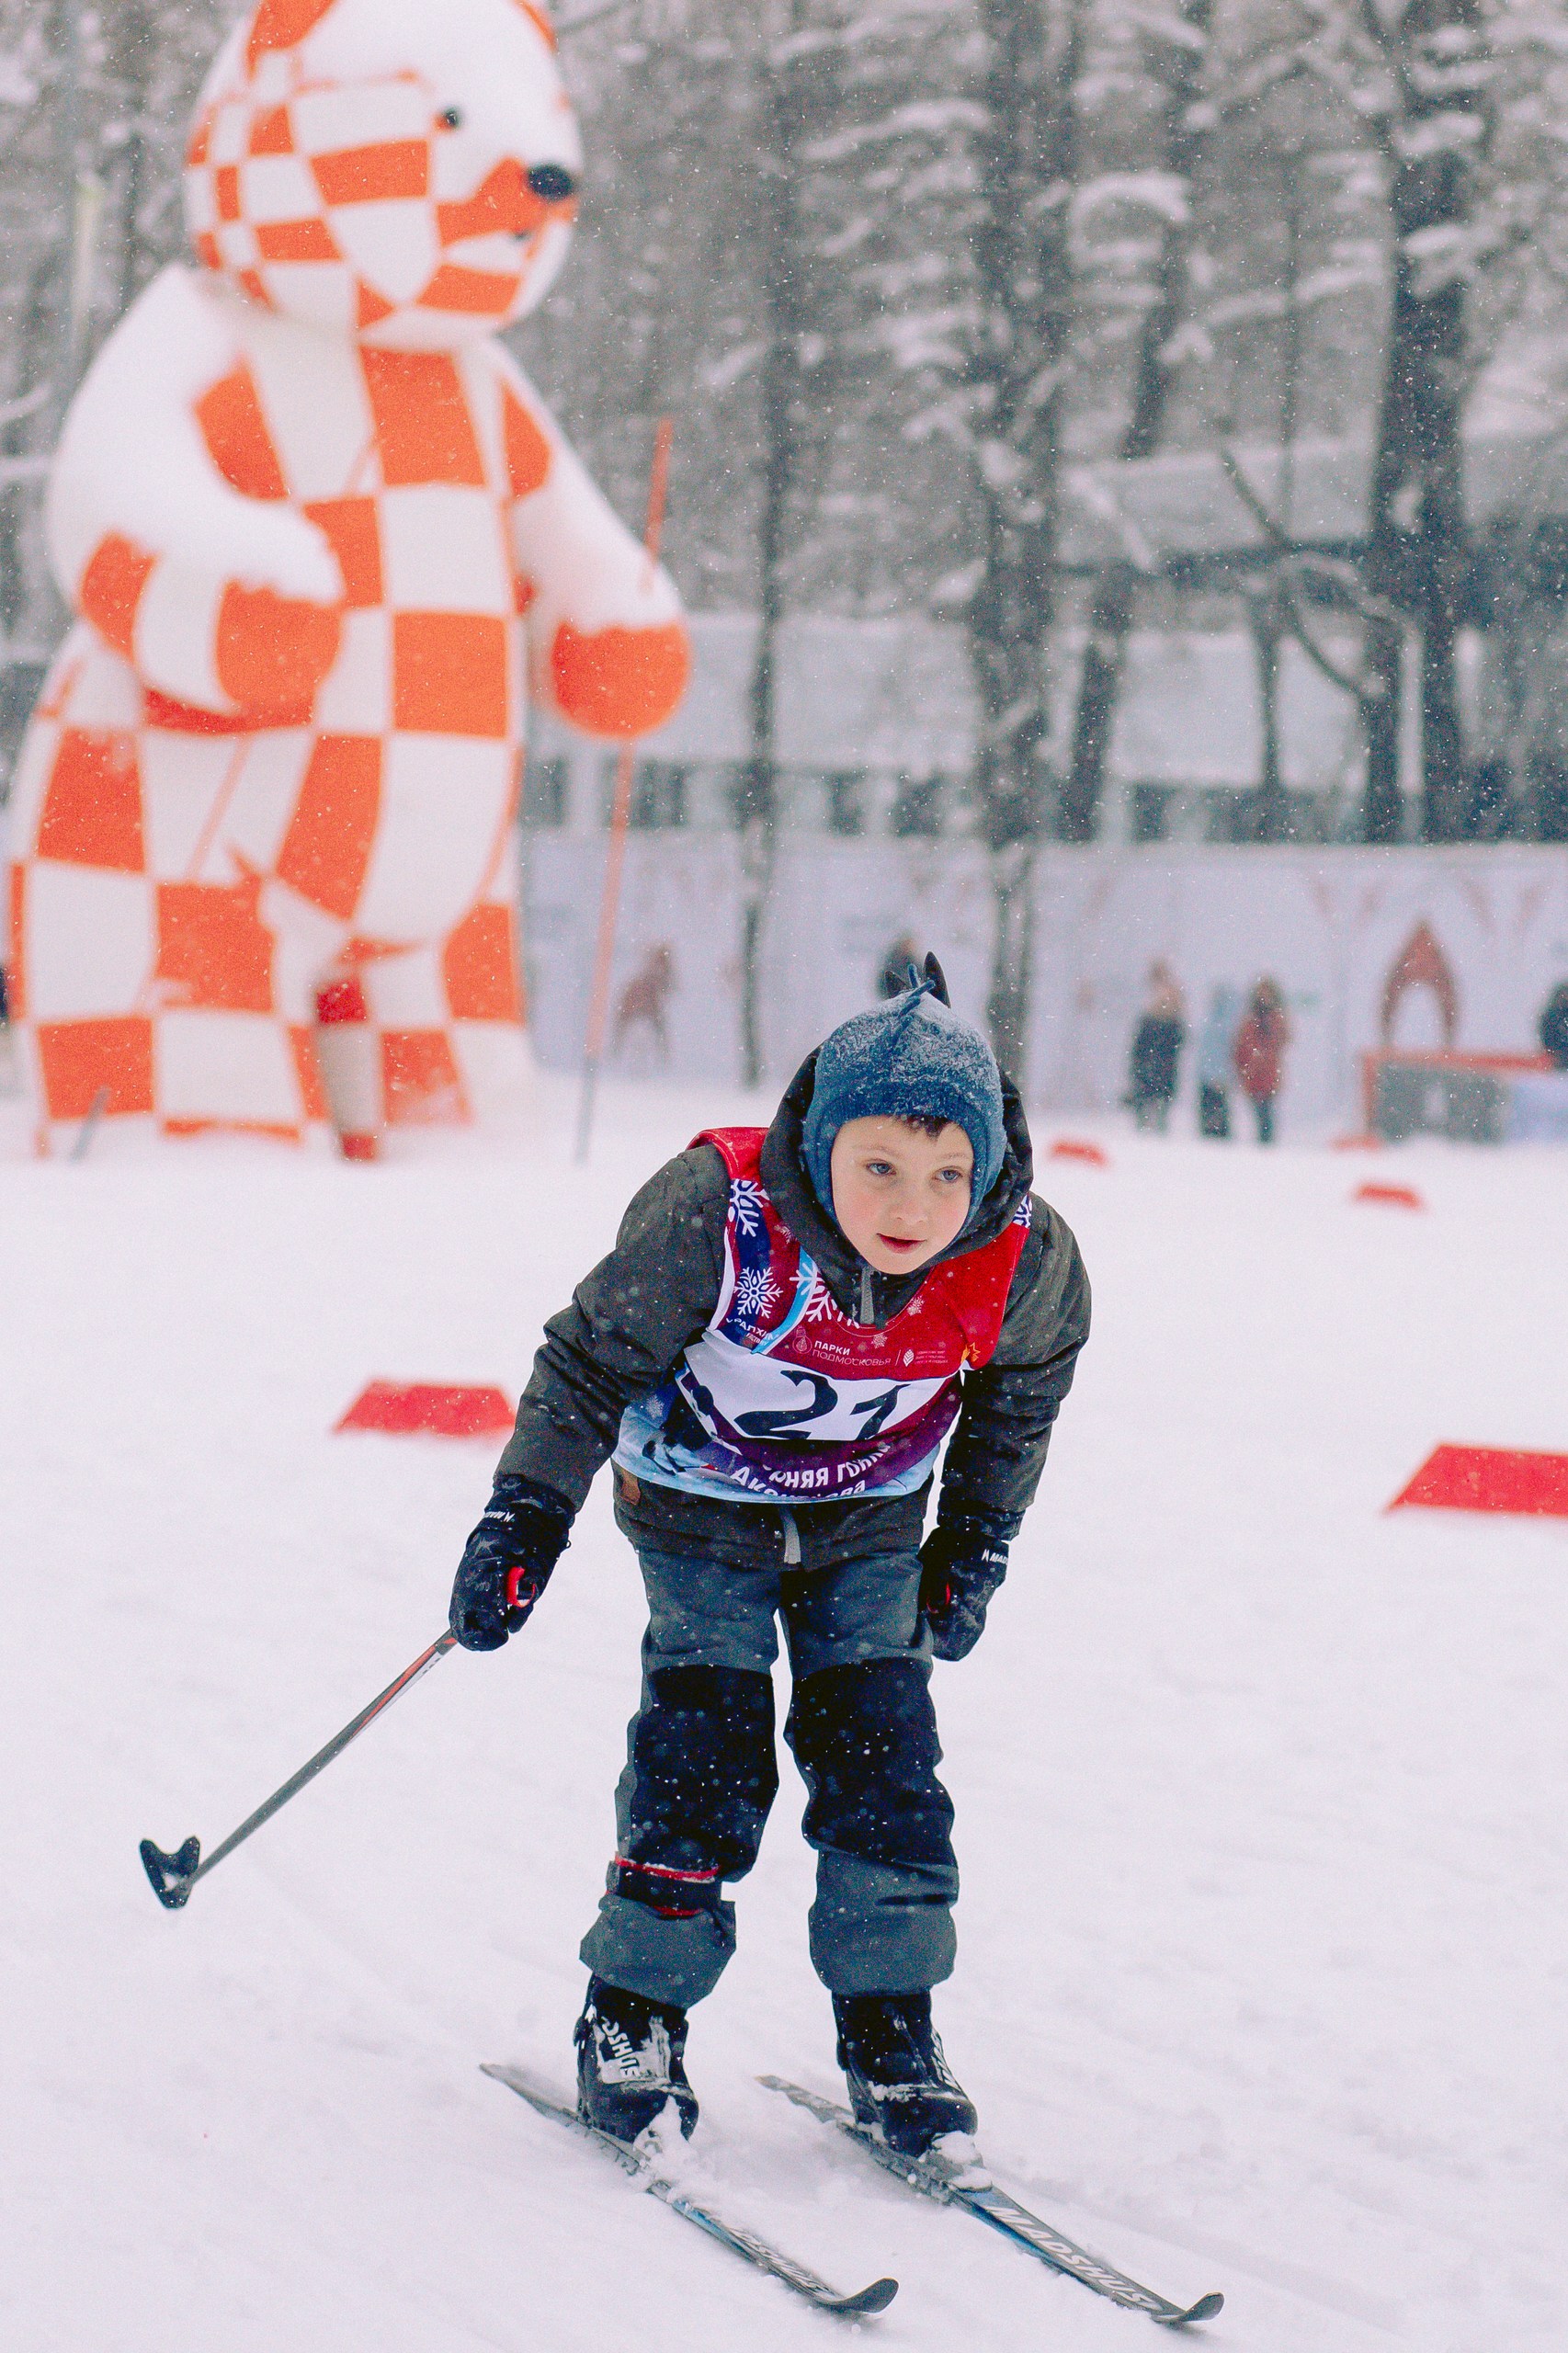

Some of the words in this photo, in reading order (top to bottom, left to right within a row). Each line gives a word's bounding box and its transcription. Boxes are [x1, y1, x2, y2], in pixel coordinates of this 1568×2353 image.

[813, 1340, 851, 1356] ПАРКИ
[812, 1349, 892, 1367] ПОДМОСКОВЬЯ
[983, 2206, 1164, 2312] MADSHUS
